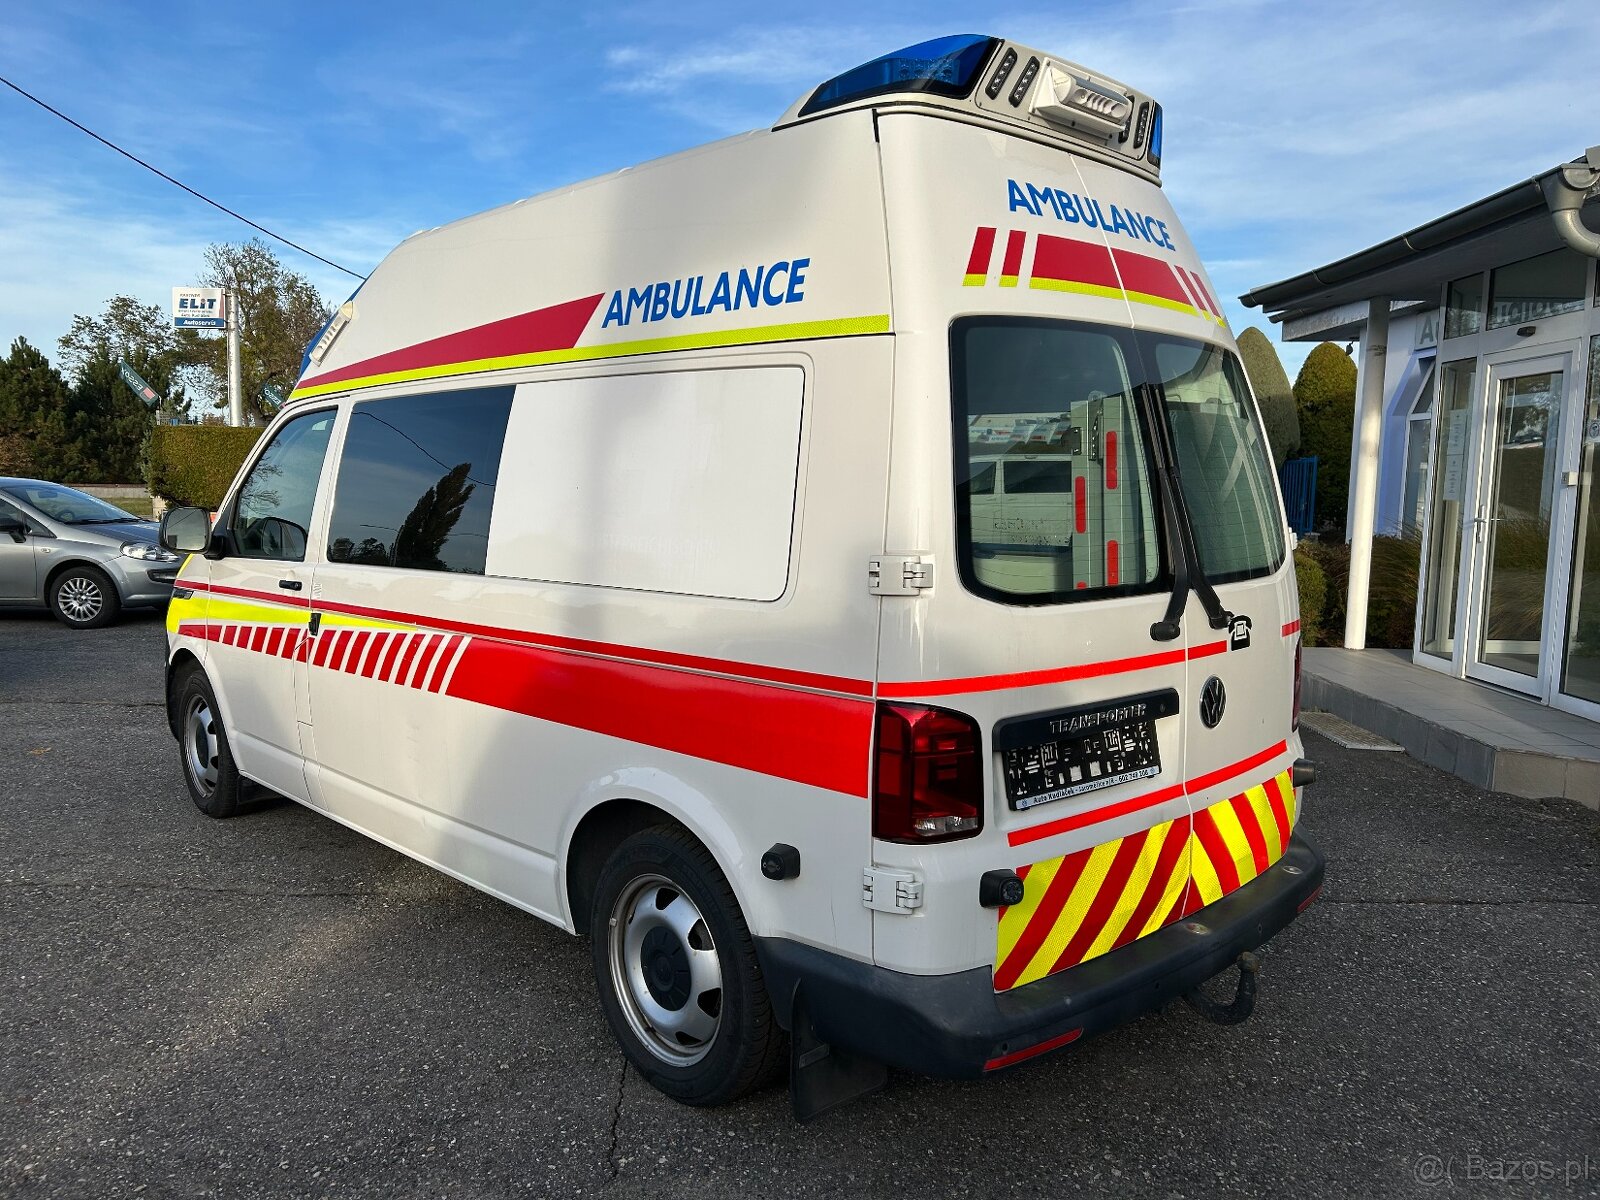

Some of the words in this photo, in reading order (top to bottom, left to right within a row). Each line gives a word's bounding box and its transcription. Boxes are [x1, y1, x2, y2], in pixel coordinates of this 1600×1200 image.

[1007, 178, 1176, 251] AMBULANCE
[601, 257, 811, 329] AMBULANCE
[1049, 703, 1147, 734] TRANSPORTER
